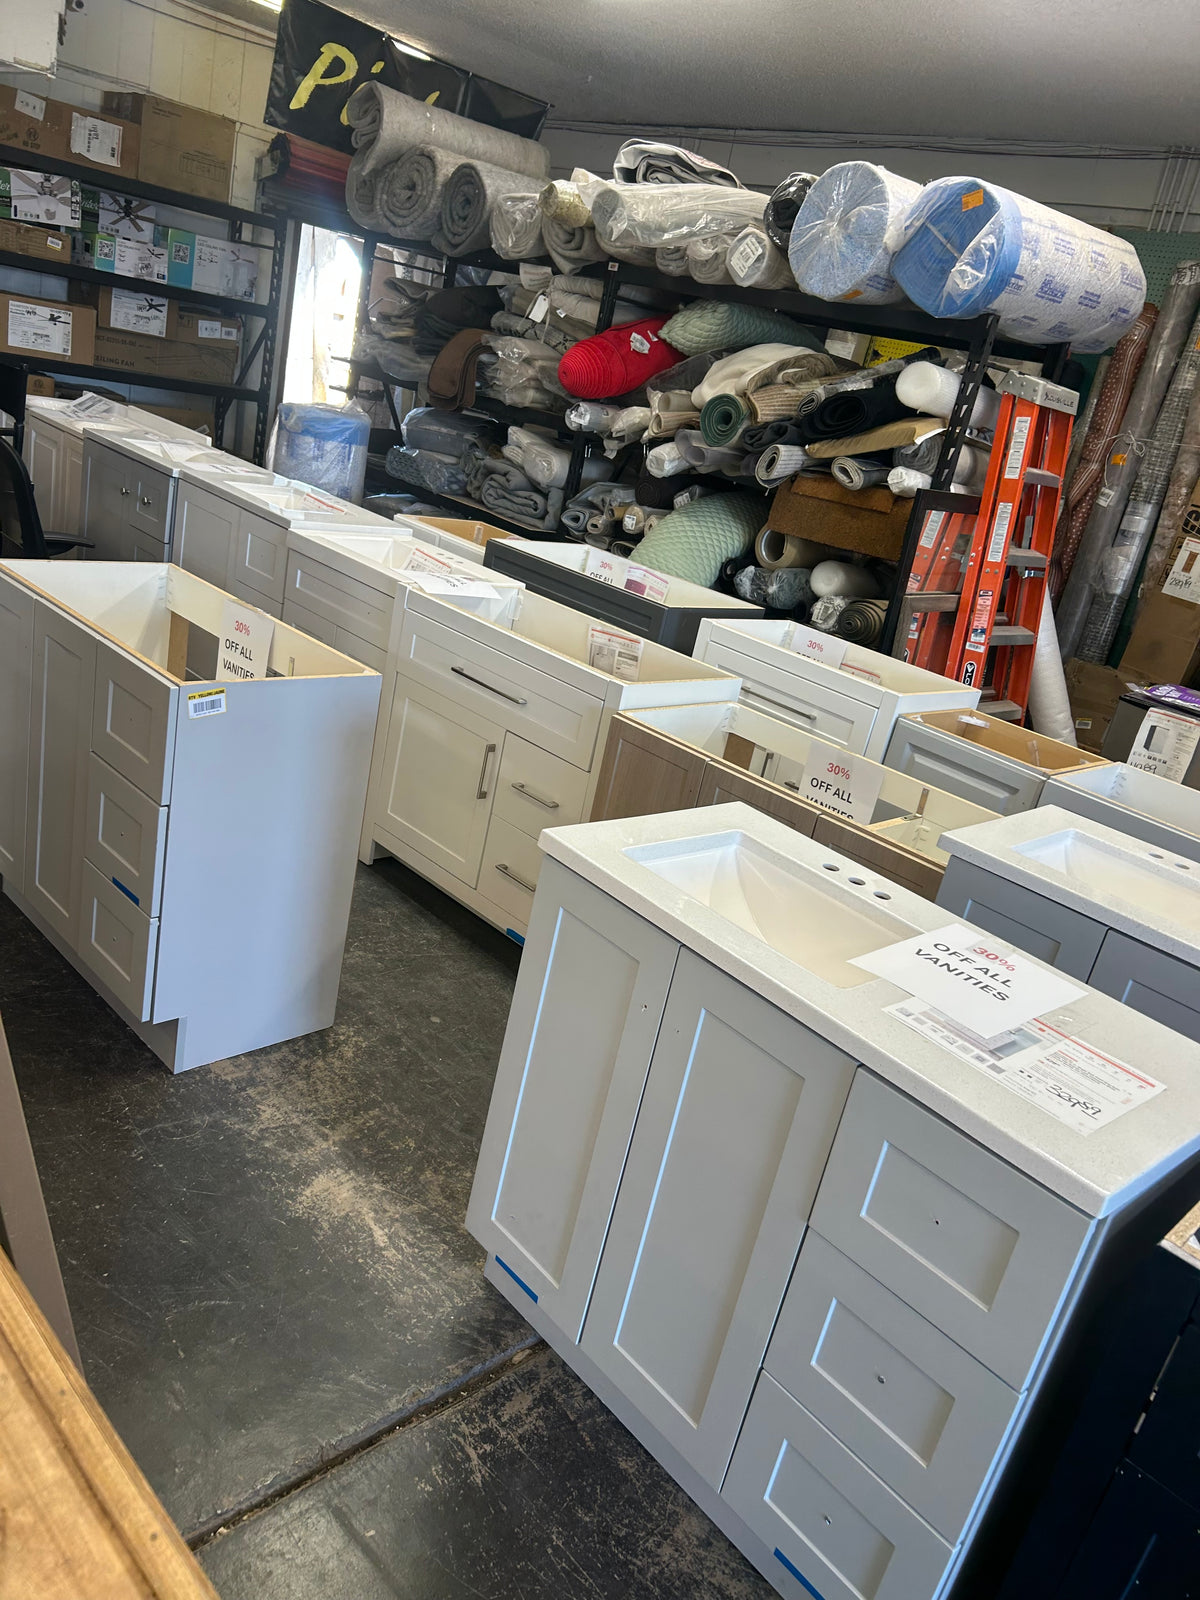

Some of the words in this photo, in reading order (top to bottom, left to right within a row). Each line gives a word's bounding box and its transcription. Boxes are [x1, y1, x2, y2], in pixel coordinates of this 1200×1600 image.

[600, 561, 613, 571] 30%
[234, 620, 251, 636] 30%
[224, 638, 239, 653] OFF
[239, 646, 253, 661] ALL
[807, 640, 824, 652] 30%
[826, 762, 850, 780] 30%
[810, 777, 833, 793] OFF
[832, 788, 853, 804] ALL
[933, 943, 976, 964] OFF
[974, 967, 1012, 988] ALL
[973, 947, 1016, 972] 30%
[915, 948, 1010, 1001] VANITIES
